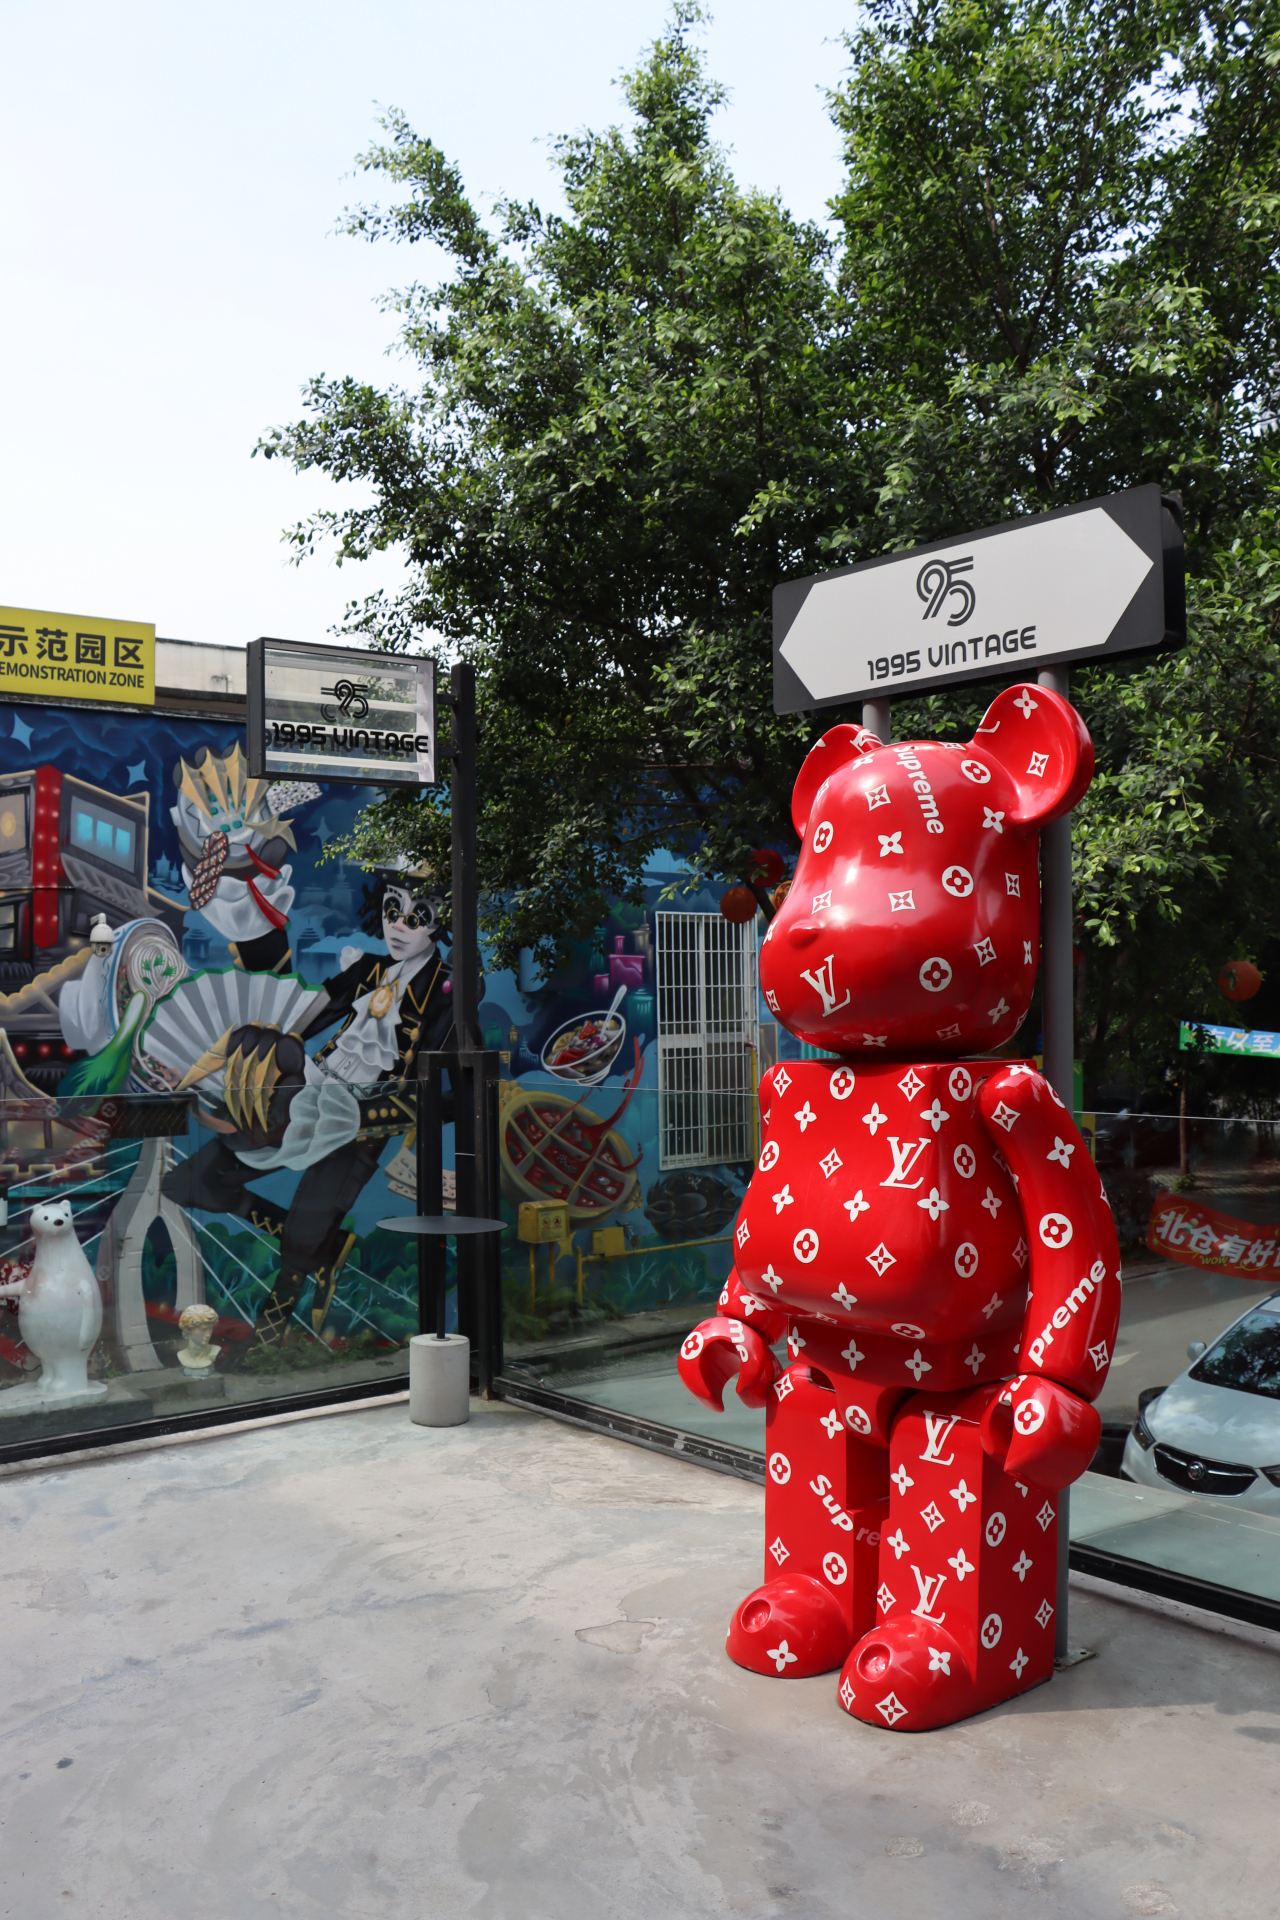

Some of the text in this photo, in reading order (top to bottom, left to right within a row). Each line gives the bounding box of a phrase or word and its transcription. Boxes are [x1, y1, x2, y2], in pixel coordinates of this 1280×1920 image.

[916, 554, 976, 627] 95
[0, 624, 144, 669] 示范园区
[867, 625, 1037, 681] 1995 VINTAGE
[109, 671, 145, 689] ZONE
[272, 722, 429, 753] 1995 VINTAGE
[893, 745, 945, 835] Supreme
